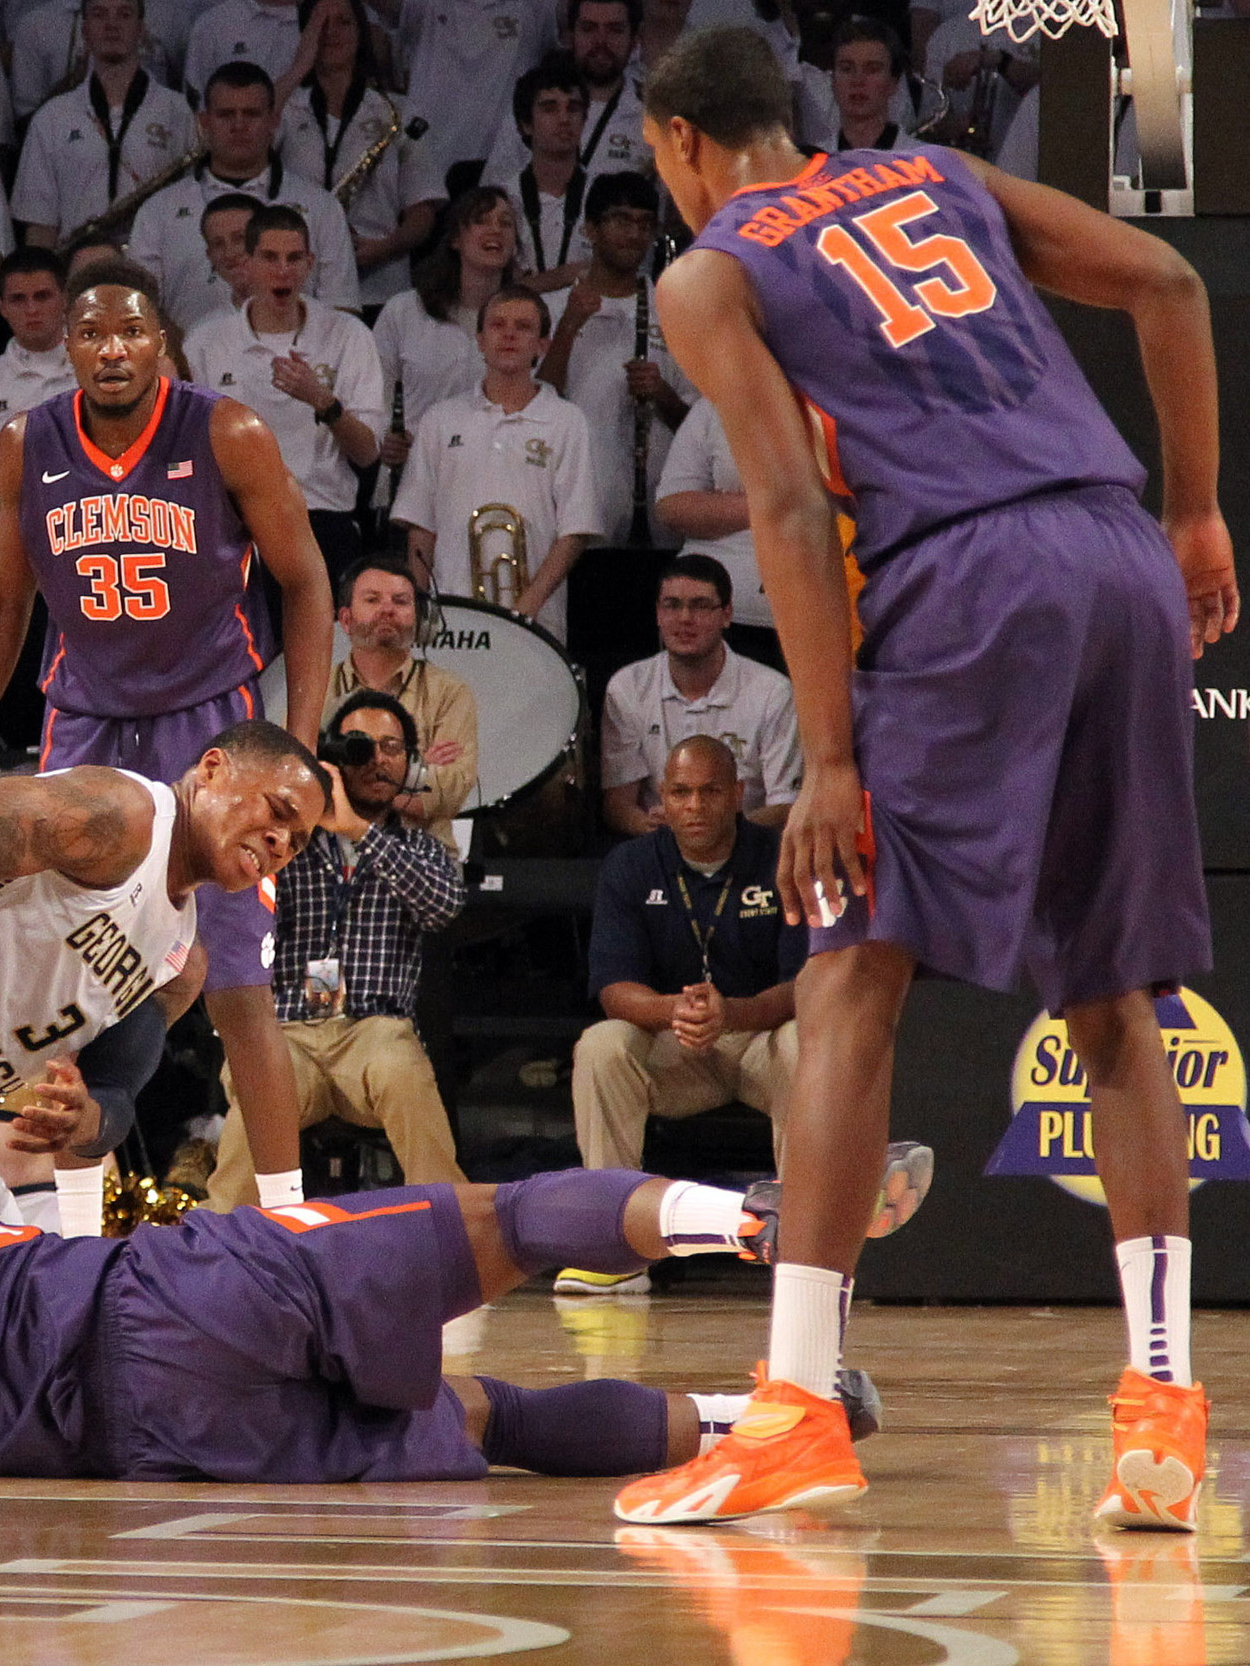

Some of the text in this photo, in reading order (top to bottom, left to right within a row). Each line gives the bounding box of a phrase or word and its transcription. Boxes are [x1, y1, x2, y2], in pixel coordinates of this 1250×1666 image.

[738, 156, 945, 247] GRANTHAM
[817, 190, 997, 348] 15
[46, 493, 198, 556] CLEMSON
[76, 553, 171, 621] 35
[65, 912, 154, 1018] GEORGI
[15, 1003, 87, 1052] 3
[1031, 1035, 1228, 1098] Suior
